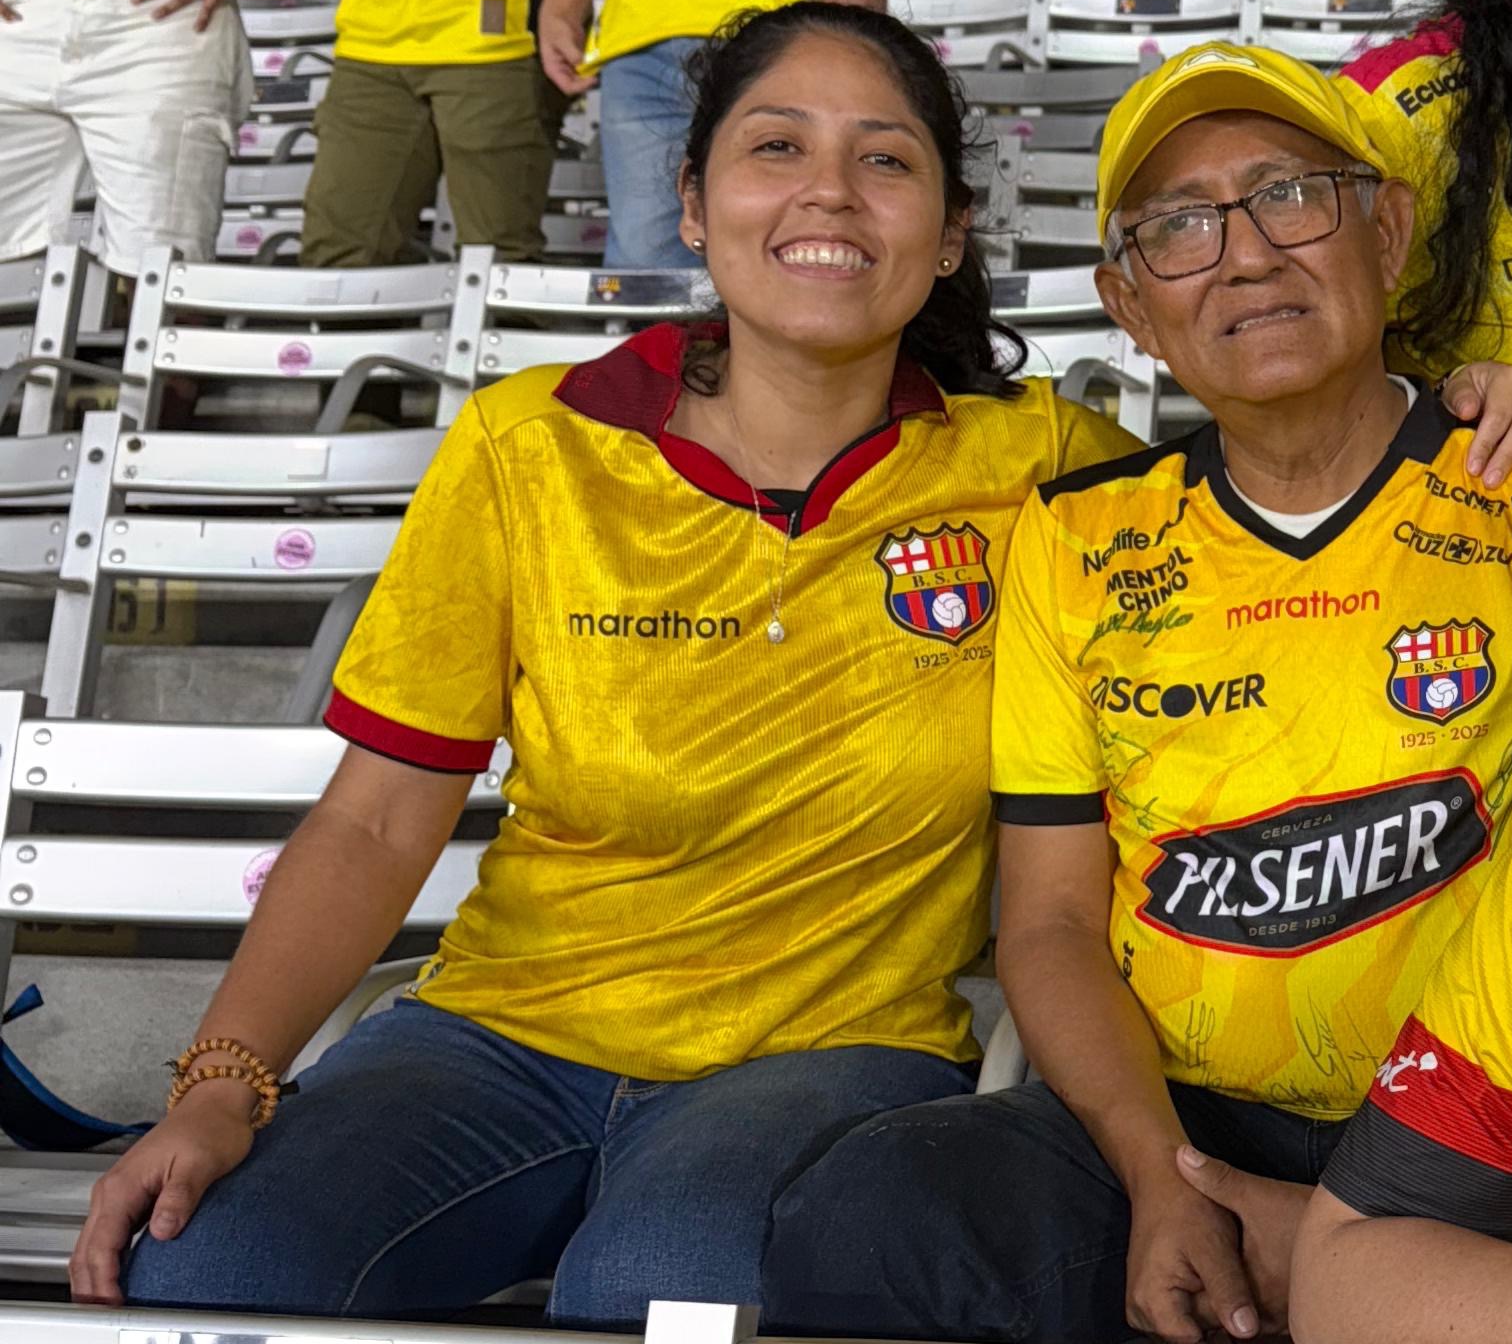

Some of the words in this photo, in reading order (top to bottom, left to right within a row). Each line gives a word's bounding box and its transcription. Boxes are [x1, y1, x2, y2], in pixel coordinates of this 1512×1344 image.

[1106, 546, 1193, 596] MENTOL
[1118, 570, 1189, 611] CHINO
[568, 609, 741, 641] marathon
[1226, 588, 1380, 630] marathon
[914, 653, 950, 670] 1925
[961, 646, 993, 661] 2025
[1400, 732, 1436, 748] 1925
[1450, 724, 1489, 740] 2025
[1261, 814, 1333, 840] CERVEZA
[1164, 799, 1449, 918] PILSENER
[1249, 921, 1299, 937] DESDE
[1305, 914, 1337, 929] 1913
